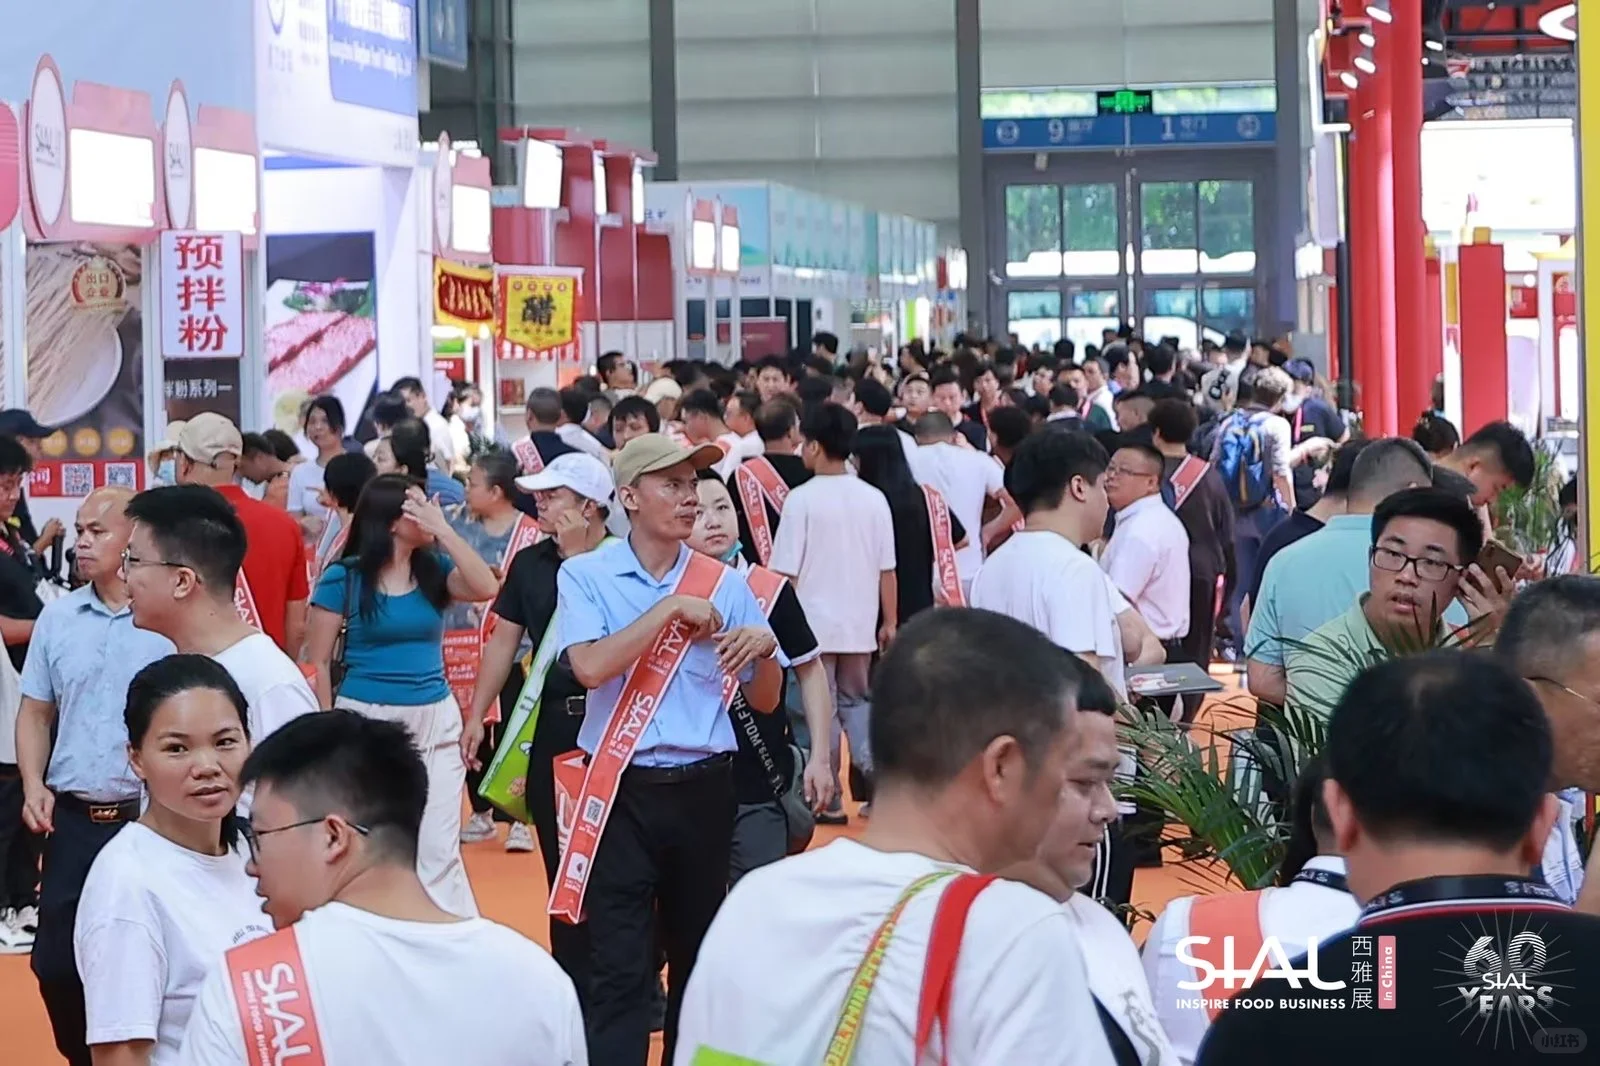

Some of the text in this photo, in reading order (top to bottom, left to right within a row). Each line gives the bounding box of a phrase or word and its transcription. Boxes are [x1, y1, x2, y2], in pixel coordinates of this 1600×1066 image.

[174, 235, 228, 352] 预拌粉
[656, 618, 690, 656] IAL
[617, 690, 654, 742] SIAL
